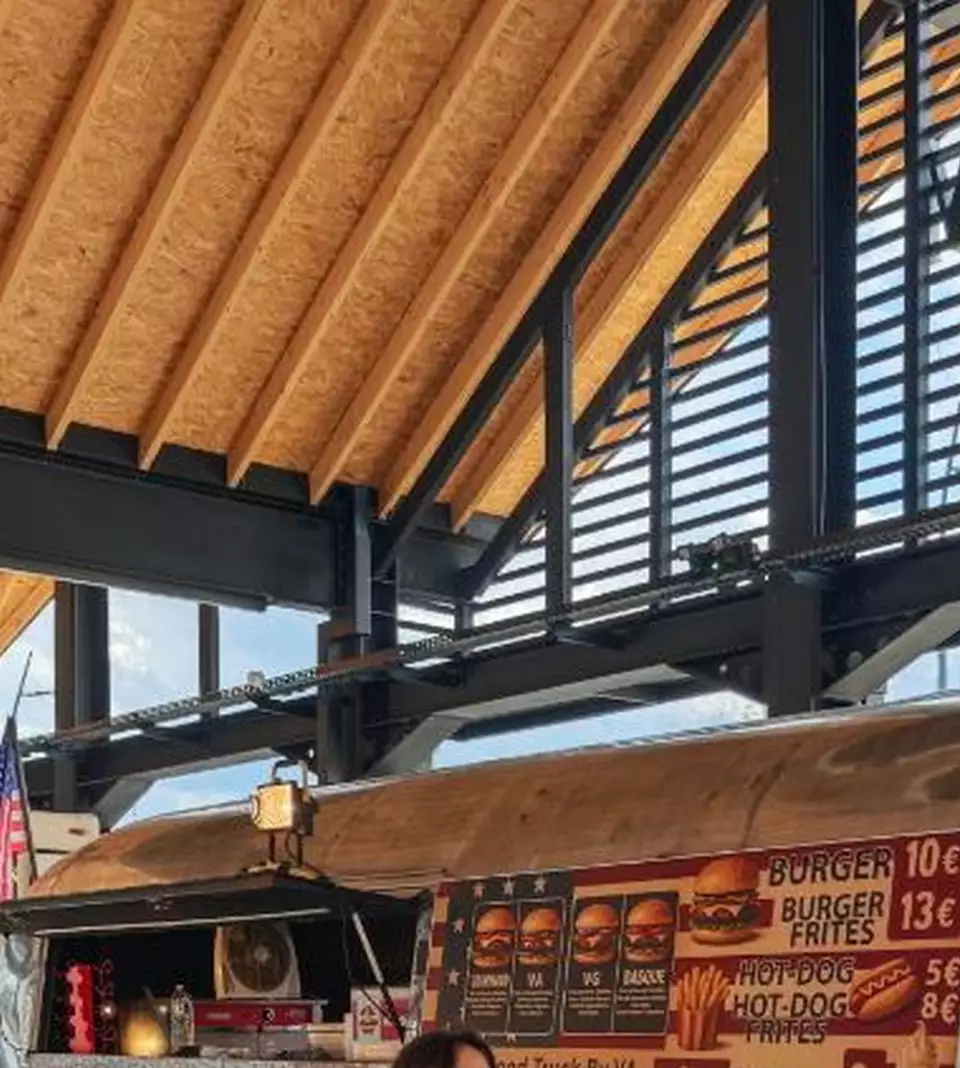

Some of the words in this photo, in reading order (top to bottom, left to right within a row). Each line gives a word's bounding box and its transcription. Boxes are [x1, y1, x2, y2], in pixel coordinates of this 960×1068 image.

[768, 846, 893, 887] BURGER
[905, 836, 960, 878] 10€
[781, 891, 885, 922] BURGER
[901, 889, 956, 931] 13€
[789, 919, 875, 947] FRITES
[740, 957, 855, 986] HOT-DOG
[733, 992, 848, 1018] HOT-DOG
[921, 992, 960, 1023] 8€
[746, 1019, 828, 1044] FRITES
